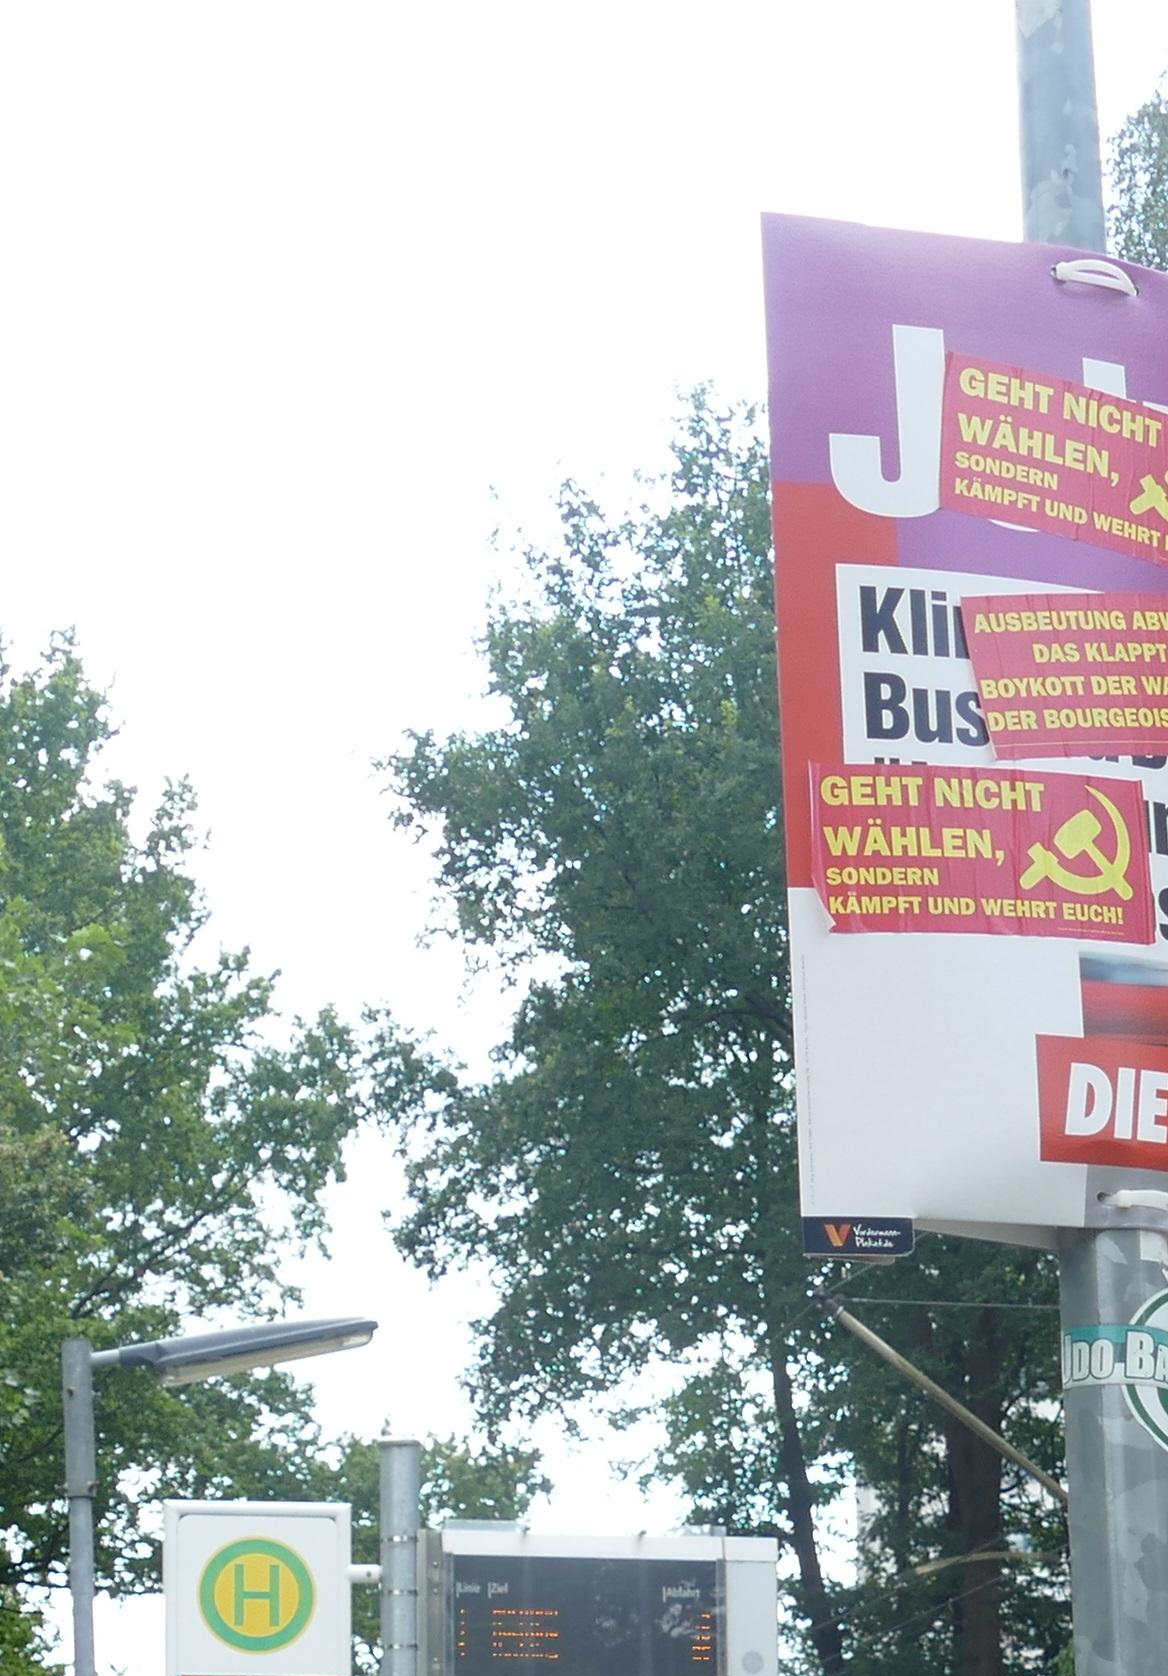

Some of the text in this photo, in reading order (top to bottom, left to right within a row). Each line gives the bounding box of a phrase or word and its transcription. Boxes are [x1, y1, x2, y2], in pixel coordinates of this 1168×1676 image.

[959, 367, 1162, 447] GEHT NICHT
[958, 413, 1119, 487] WÄHLEN,
[955, 451, 1058, 490] SONDERN
[955, 477, 1040, 512] KÄMPFT
[1044, 498, 1088, 525] UND
[1093, 511, 1160, 547] WEHRT
[974, 610, 1126, 634] AUSBEUTUNG
[1032, 643, 1081, 664] DAS
[1086, 643, 1168, 663] KLAPPT
[980, 676, 1085, 700] BOYKOTT
[1091, 676, 1136, 696] DER
[863, 671, 990, 747] Bus
[987, 710, 1038, 733] DER
[820, 775, 1044, 812] GEHT NICHT
[823, 818, 1005, 866] WÄHLEN,
[826, 867, 939, 886] SONDERN
[829, 892, 1125, 925] KÄMPFT UND WEHRT EUCH!
[234, 1564, 280, 1627] H
